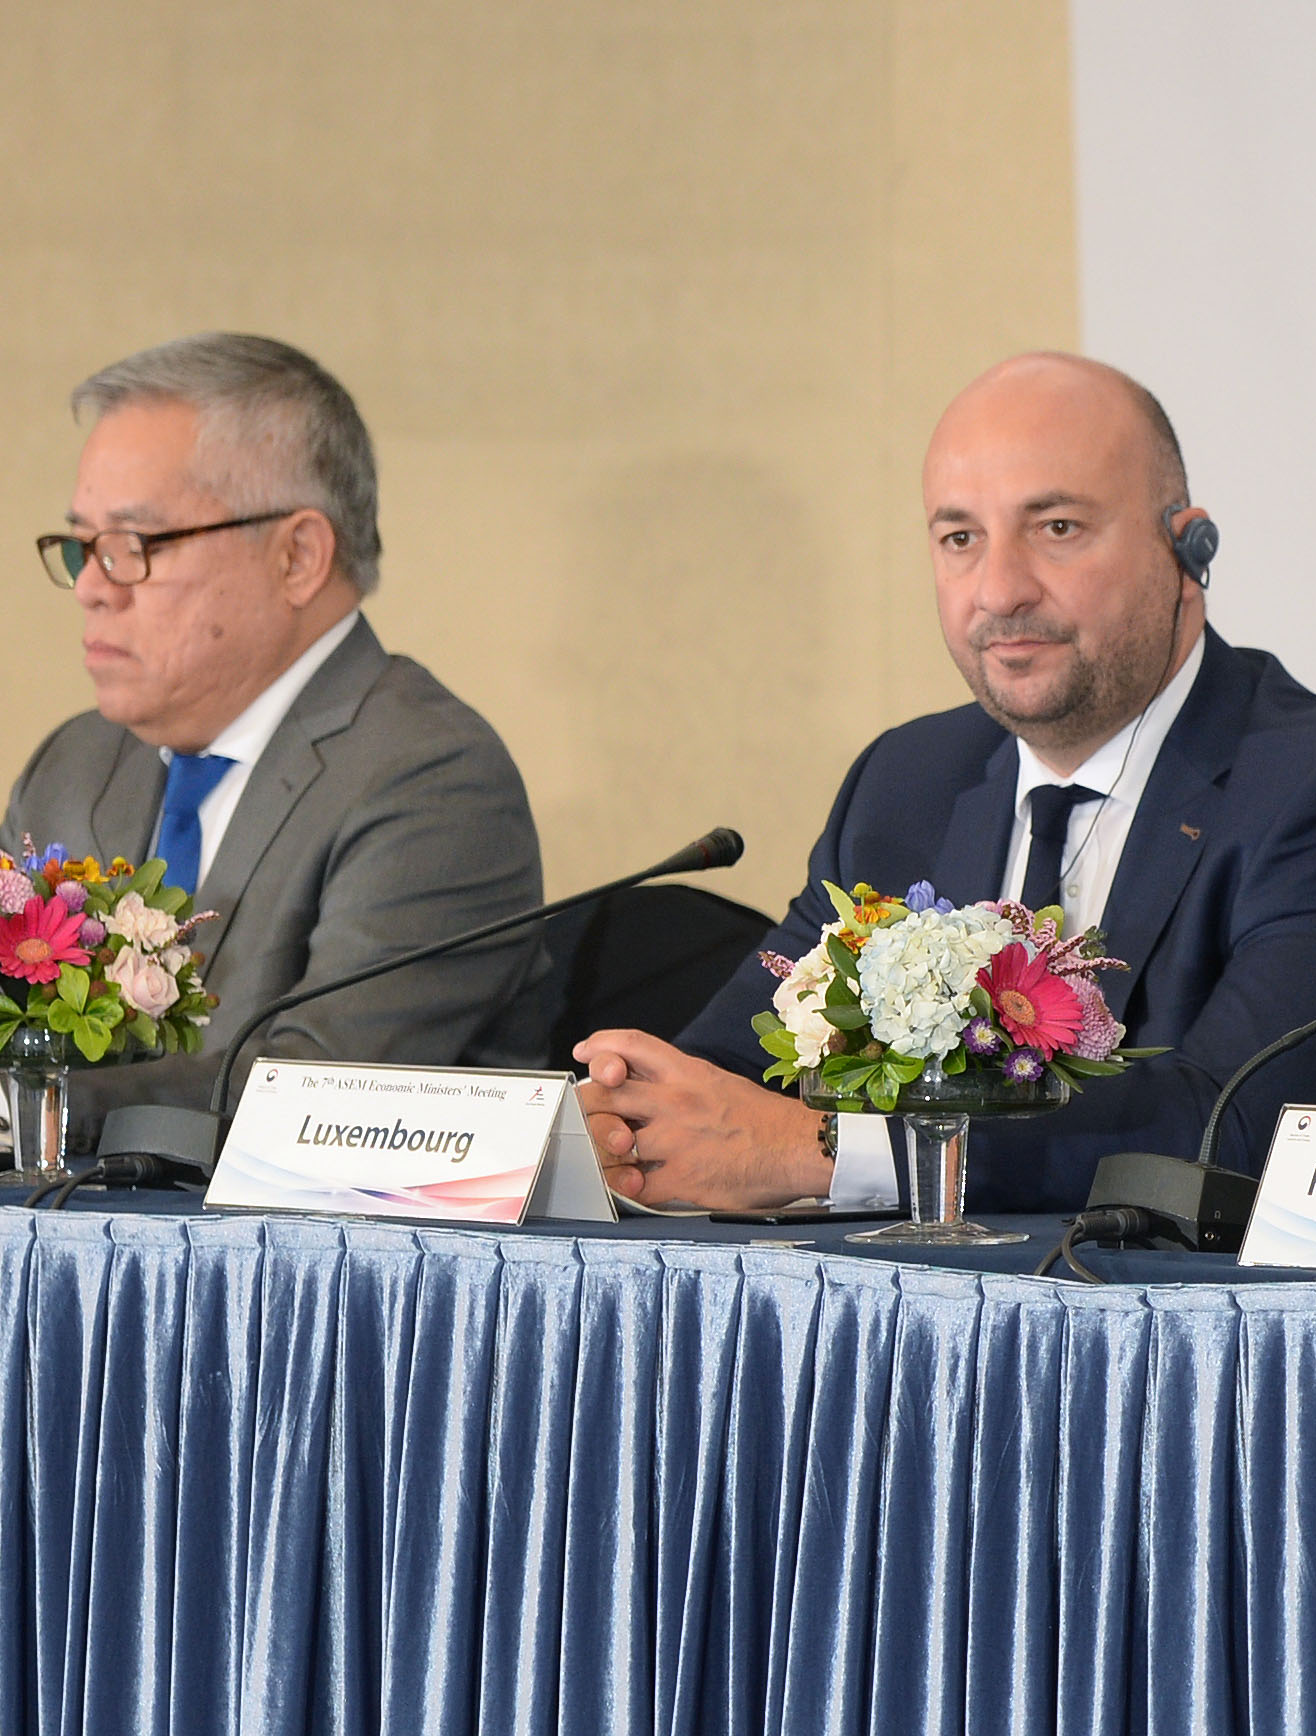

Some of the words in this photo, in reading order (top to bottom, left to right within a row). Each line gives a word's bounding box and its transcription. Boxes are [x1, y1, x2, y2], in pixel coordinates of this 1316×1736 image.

[302, 1076, 319, 1088] The
[335, 1079, 368, 1091] ASEM
[368, 1080, 415, 1094] Economic
[468, 1085, 507, 1101] Meeting
[296, 1114, 475, 1164] Luxembourg
